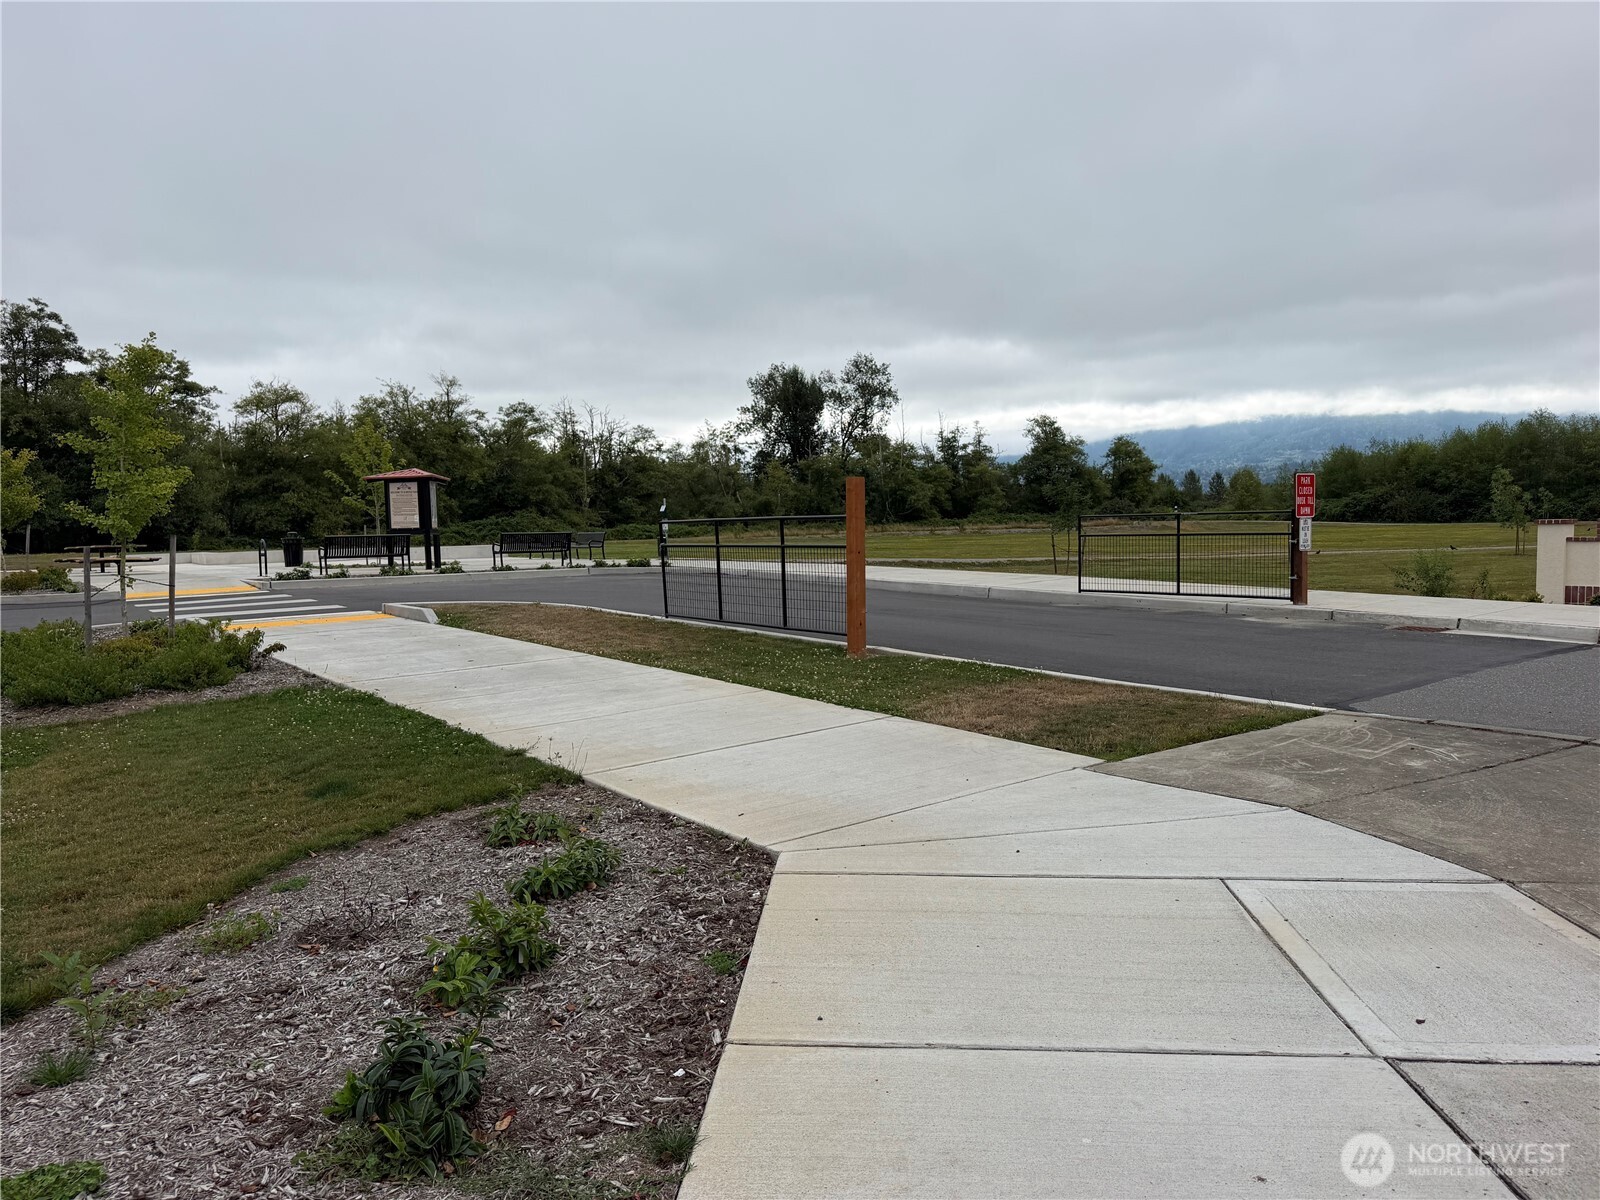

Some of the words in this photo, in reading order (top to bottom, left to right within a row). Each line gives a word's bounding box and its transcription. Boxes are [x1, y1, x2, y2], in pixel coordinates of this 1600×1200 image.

[1301, 476, 1311, 484] PARK
[1299, 486, 1313, 494] CLOSED
[1297, 496, 1306, 504] DUSK
[1300, 506, 1311, 514] DAWN
